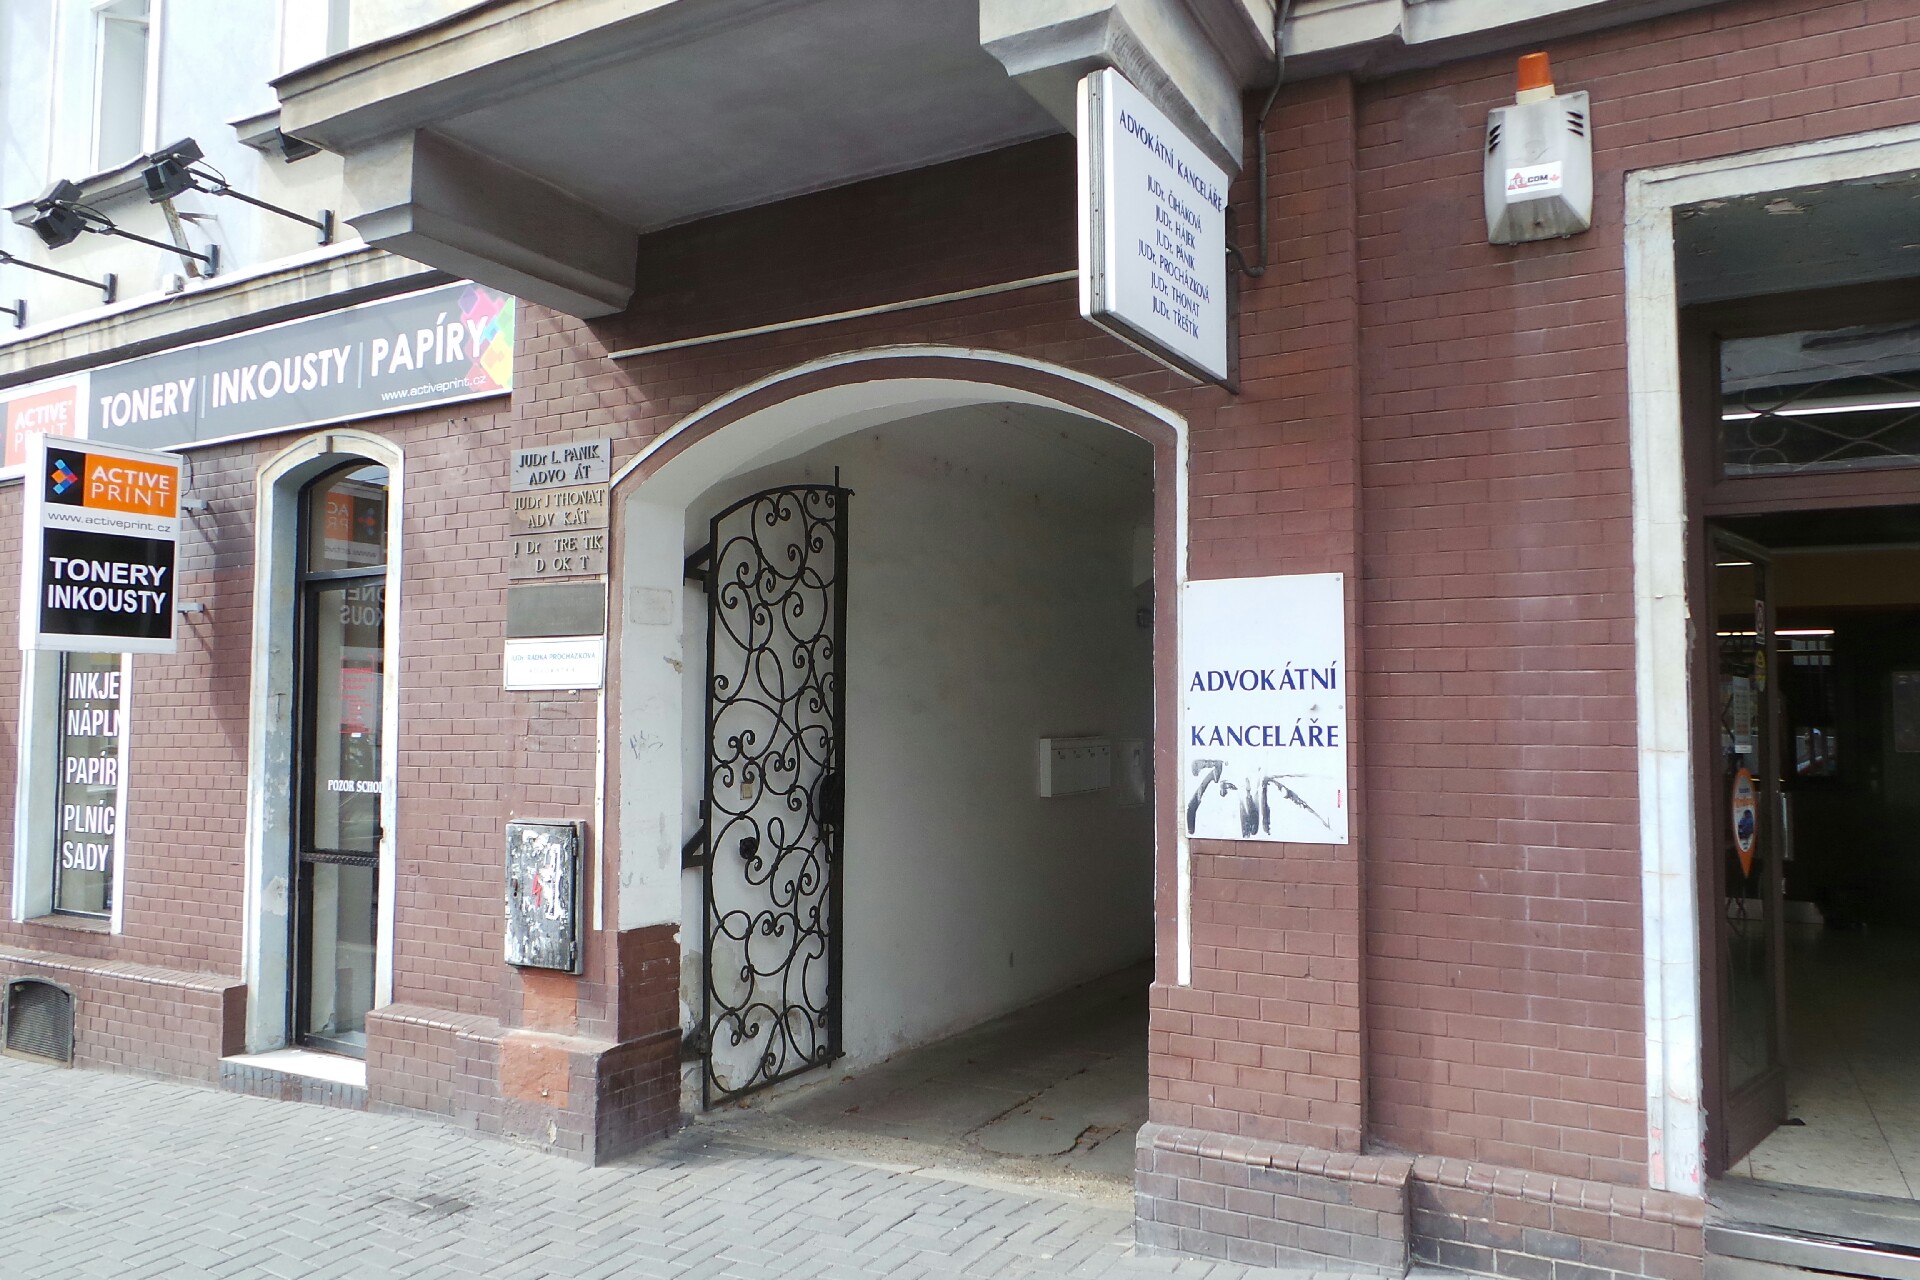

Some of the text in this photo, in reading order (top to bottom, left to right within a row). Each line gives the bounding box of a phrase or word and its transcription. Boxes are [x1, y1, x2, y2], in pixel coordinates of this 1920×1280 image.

[1119, 109, 1222, 213] ADVOKÁTNÍ KANCELÁŘE
[1147, 175, 1202, 233] JUDr. ČIHÁKOVÁ
[1155, 205, 1196, 250] JUDr. HÁJEK
[1156, 229, 1195, 271] JUDr. PÁNIK
[1138, 239, 1210, 303] JUDr. PROCHÁZKOVÁ
[1151, 272, 1200, 318] JUDr. THONAT
[1152, 295, 1199, 339] JUDr. TŘEŠTÍK
[101, 312, 488, 428] TONERY INKOUSTY PAPÍRY
[381, 375, 487, 401] www.activeprint.cz
[15, 401, 67, 430] ACTIVE
[91, 465, 170, 490] ACTIVE
[91, 484, 171, 508] PRINT
[554, 489, 605, 506] THONAT
[48, 512, 171, 533] www.activeprint.cz
[49, 556, 167, 586] TONERY
[47, 584, 167, 614] INKOUSTY
[69, 671, 121, 700] INKJE
[1190, 660, 1337, 692] ADVOKÁTNÍ
[1191, 717, 1339, 747] KANCELÁŘE
[327, 779, 355, 792] POZOR
[62, 841, 110, 872] SADY
